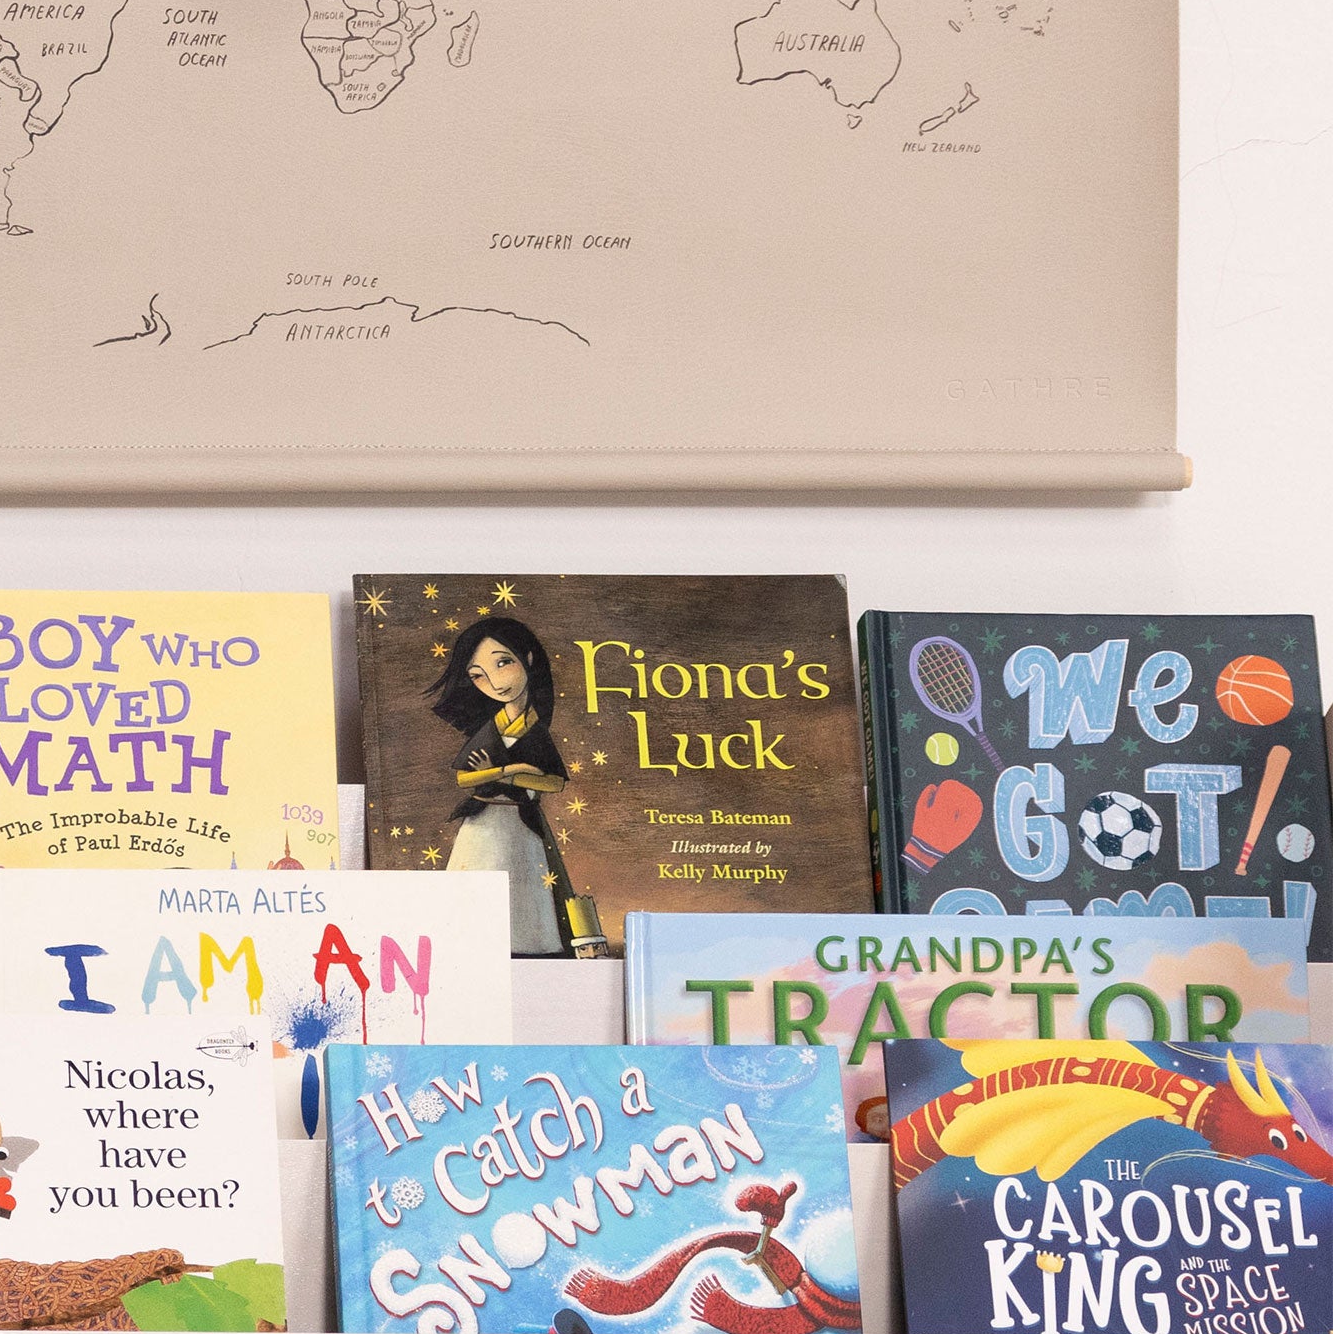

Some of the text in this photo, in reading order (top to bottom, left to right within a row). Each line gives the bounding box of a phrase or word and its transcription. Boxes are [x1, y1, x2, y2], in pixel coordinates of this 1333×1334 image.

[4, 3, 85, 21] AMERICA
[162, 8, 219, 25] SOUTH
[41, 42, 88, 57] BRAZIL
[167, 31, 228, 47] ATLANTIC
[772, 32, 866, 54] AUSTRALIA
[179, 52, 228, 68] OCEAN
[345, 92, 377, 102] AFRICA
[902, 142, 982, 154] NEW ZEALAND
[489, 233, 631, 250] SOUTHERN OCEAN
[286, 273, 379, 288] SOUTH POLE
[285, 323, 391, 342] ANTARCTICA
[947, 376, 1112, 400] GATHRE
[140, 633, 261, 669] WHO
[574, 639, 831, 714] Fiona's
[627, 711, 796, 777] Luck
[282, 803, 325, 825] 1039
[644, 808, 792, 826] Teresa Bateman
[0, 808, 232, 844] The Improbable Life
[48, 834, 68, 856] of
[75, 834, 121, 851] Paul
[670, 839, 772, 857] Illustrated by
[657, 863, 788, 884] Kelly Murphy
[159, 884, 327, 915] MARTA ALTÉS
[815, 936, 1116, 975] GRANDPA'S
[44, 923, 433, 1017] I AM AN
[686, 979, 1243, 1065] TRACTOR
[63, 1059, 216, 1097] Nicolas,
[82, 1102, 200, 1129] where
[432, 1071, 605, 1216] Catch
[619, 1067, 656, 1116] a
[98, 1141, 187, 1171] have
[1104, 1159, 1141, 1181] THE
[48, 1179, 241, 1213] you been?
[993, 1177, 1318, 1255] CAROUSEL
[1180, 1256, 1231, 1273] AND THE
[1175, 1264, 1290, 1316] SPACE
